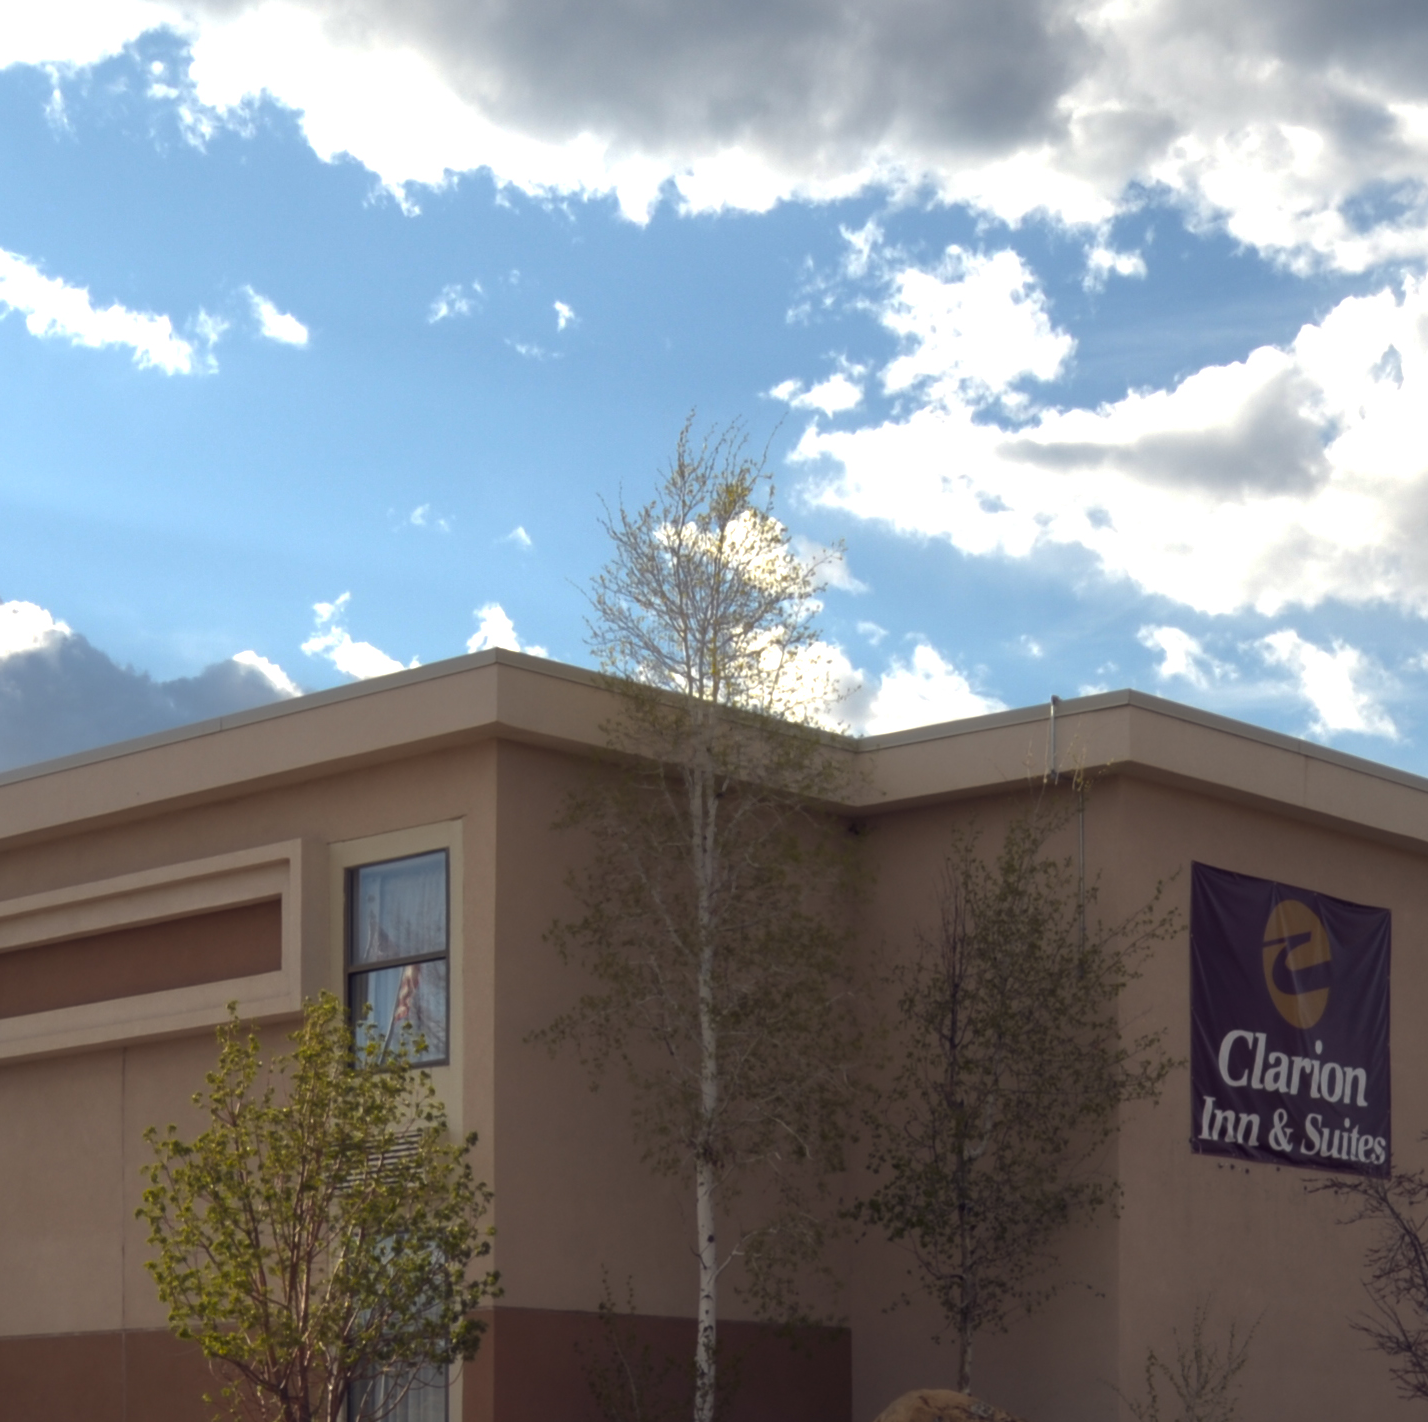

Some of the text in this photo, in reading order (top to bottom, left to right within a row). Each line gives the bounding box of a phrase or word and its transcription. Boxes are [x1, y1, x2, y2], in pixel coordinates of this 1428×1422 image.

[1218, 1029, 1368, 1107] Clarion
[1198, 1095, 1387, 1165] Inn & Suites
